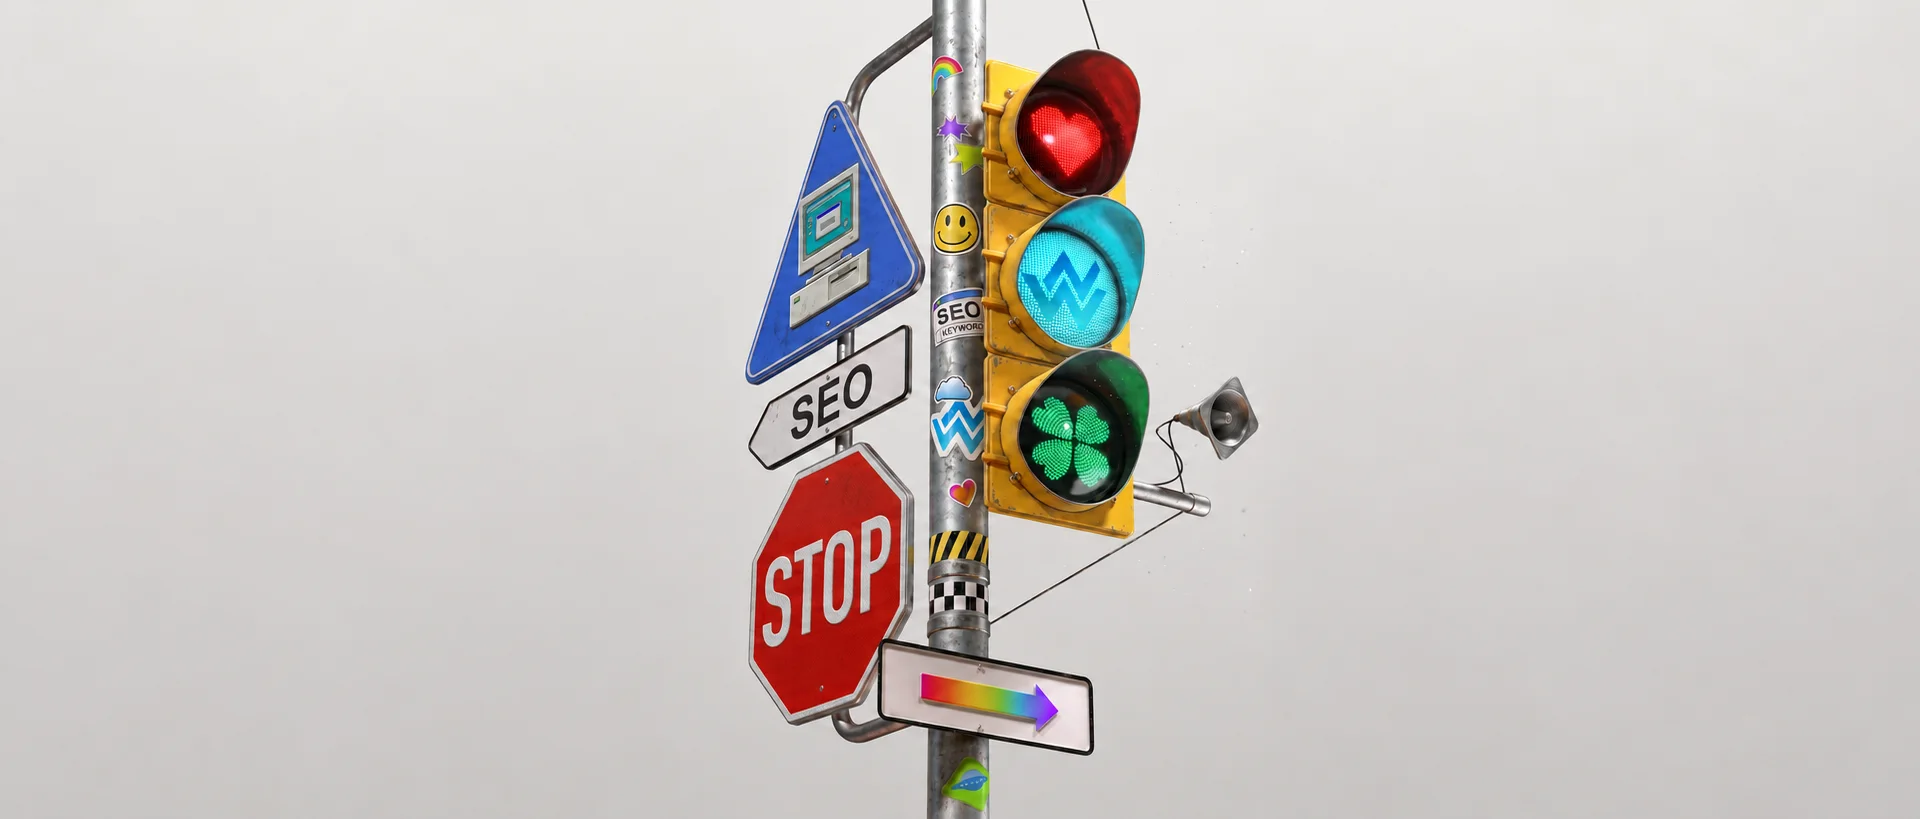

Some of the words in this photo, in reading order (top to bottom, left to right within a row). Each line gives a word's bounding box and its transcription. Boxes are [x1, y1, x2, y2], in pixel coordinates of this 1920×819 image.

[937, 301, 981, 325] SEO
[790, 363, 872, 440] SEO
[762, 514, 892, 648] STOP
